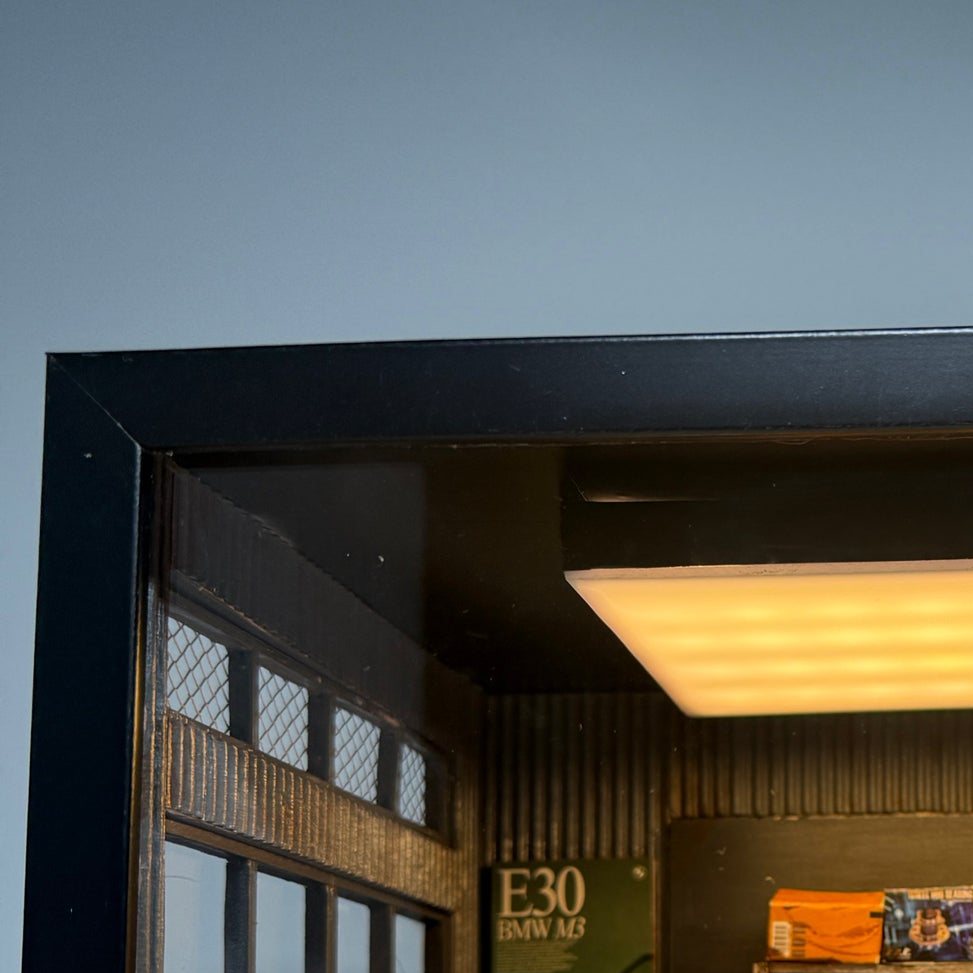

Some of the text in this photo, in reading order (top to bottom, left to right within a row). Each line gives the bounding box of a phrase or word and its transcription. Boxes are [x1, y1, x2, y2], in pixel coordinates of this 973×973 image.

[498, 865, 586, 917] E30
[498, 916, 586, 940] BMW M3
